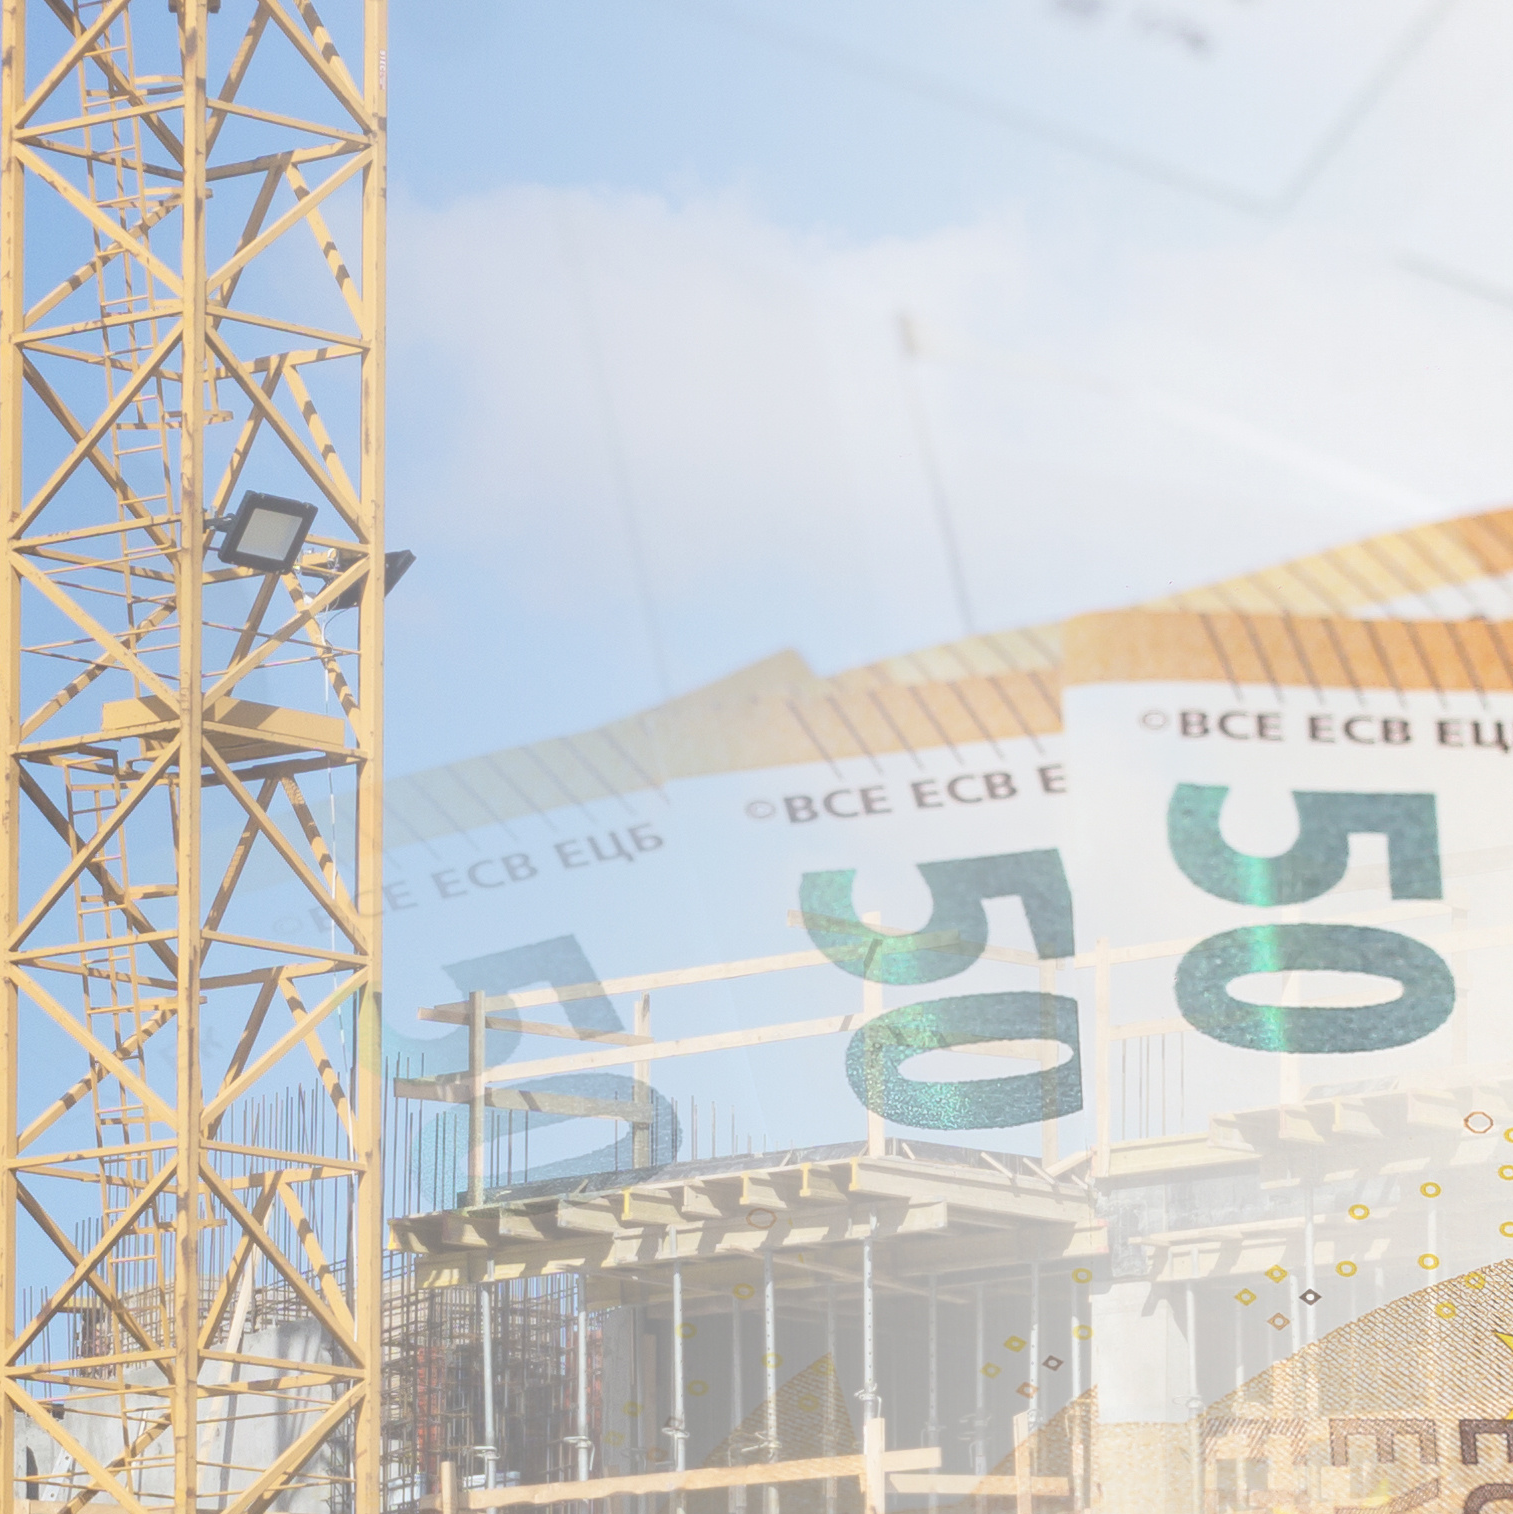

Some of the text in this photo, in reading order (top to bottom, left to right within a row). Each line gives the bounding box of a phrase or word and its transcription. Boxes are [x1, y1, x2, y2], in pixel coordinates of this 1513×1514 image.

[1309, 714, 1411, 745] ECB
[911, 771, 1018, 809] ECB
[431, 852, 538, 900] ECB
[553, 822, 665, 872] ЕЦБ
[1167, 782, 1456, 1054] 50
[799, 848, 1083, 1131] 50
